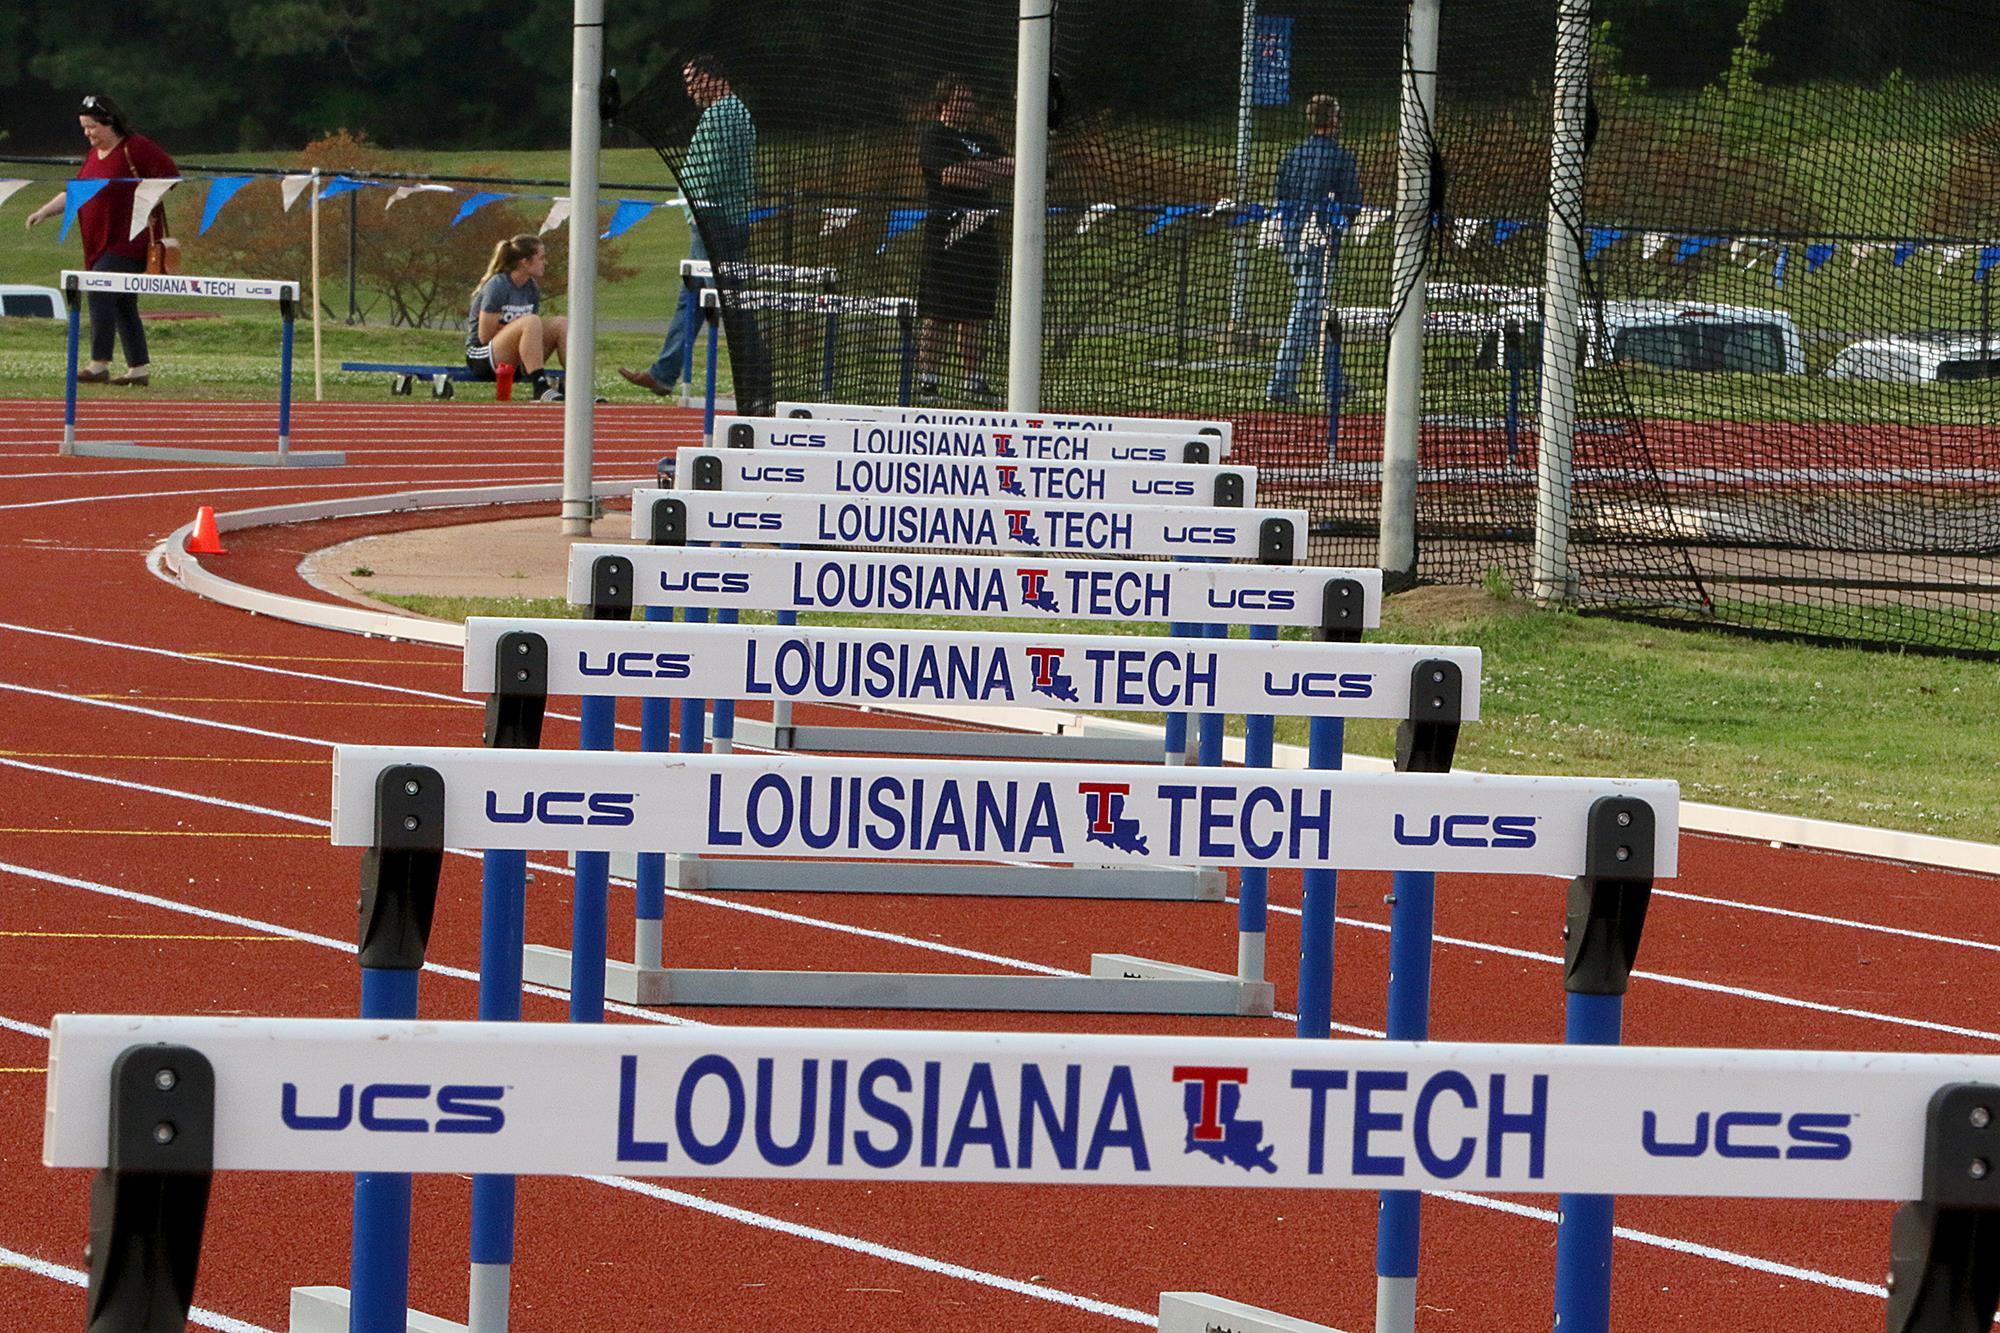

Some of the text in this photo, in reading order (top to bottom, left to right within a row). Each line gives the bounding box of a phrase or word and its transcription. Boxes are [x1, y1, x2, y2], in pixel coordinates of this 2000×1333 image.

[86, 279, 112, 287] UCS
[124, 277, 187, 293] LOUISIANA
[204, 281, 236, 296] TECH
[246, 287, 272, 295] UCS
[771, 433, 826, 448] UCS
[853, 428, 986, 457] LOUISIANA
[1022, 435, 1088, 460] TECH
[1112, 447, 1167, 461] UCS
[741, 466, 805, 483] UCS
[836, 460, 990, 497] LOUISIANA
[1030, 467, 1105, 500] TECH
[1132, 479, 1195, 496] UCS
[708, 511, 783, 530] UCS
[818, 503, 997, 545] LOUISIANA
[1044, 510, 1133, 550] TECH
[1163, 526, 1236, 545] UCS
[660, 570, 750, 593] UCS
[793, 561, 1009, 612] LOUISIANA
[1065, 570, 1171, 617] TECH
[1208, 589, 1295, 610] UCS
[578, 651, 691, 679] UCS
[745, 639, 1015, 702] LOUISIANA
[1085, 649, 1217, 707] TECH
[1264, 671, 1373, 699] UCS
[485, 790, 635, 826] UCS
[707, 773, 1065, 854] LOUISIANA
[1157, 784, 1332, 861] TECH
[1393, 813, 1537, 849] UCS
[281, 1082, 506, 1134] UCS
[616, 1054, 1151, 1172] LOUISIANA
[1290, 1068, 1549, 1180] TECH
[1641, 1110, 1852, 1161] UCS
